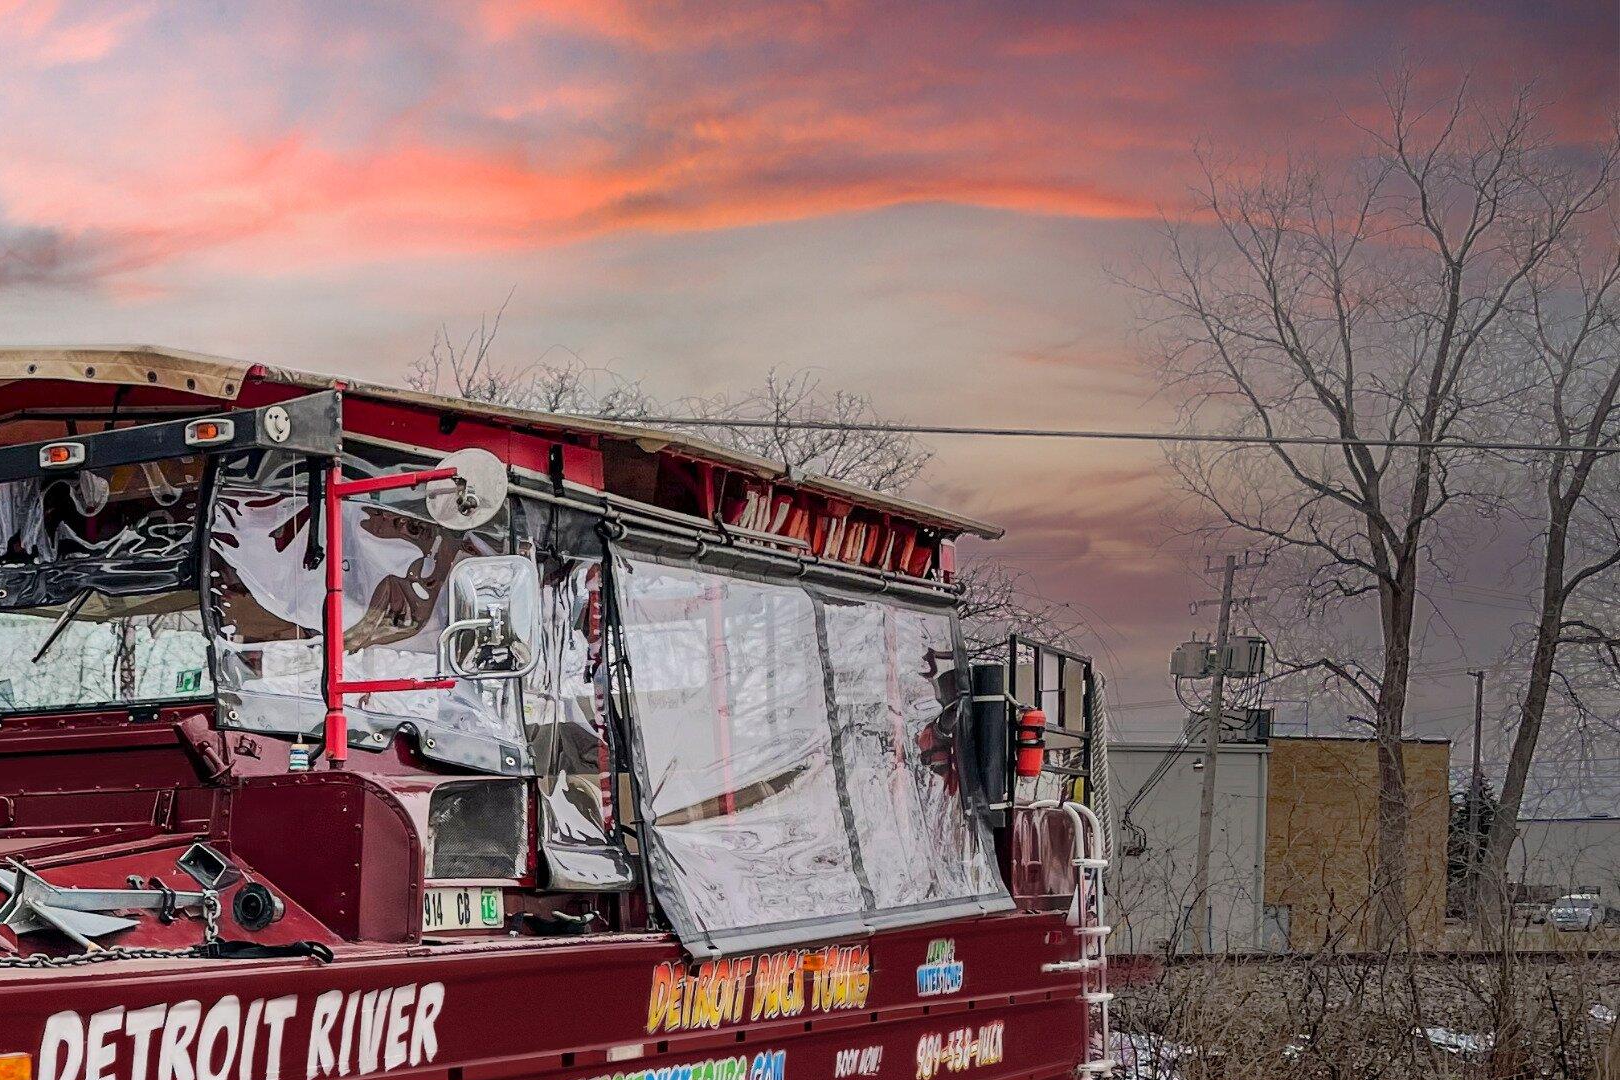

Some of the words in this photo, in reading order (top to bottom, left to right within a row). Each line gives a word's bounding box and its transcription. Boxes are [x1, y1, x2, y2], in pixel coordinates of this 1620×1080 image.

[424, 892, 443, 926] 914
[482, 896, 497, 918] 19
[646, 956, 754, 1035] DETROIT
